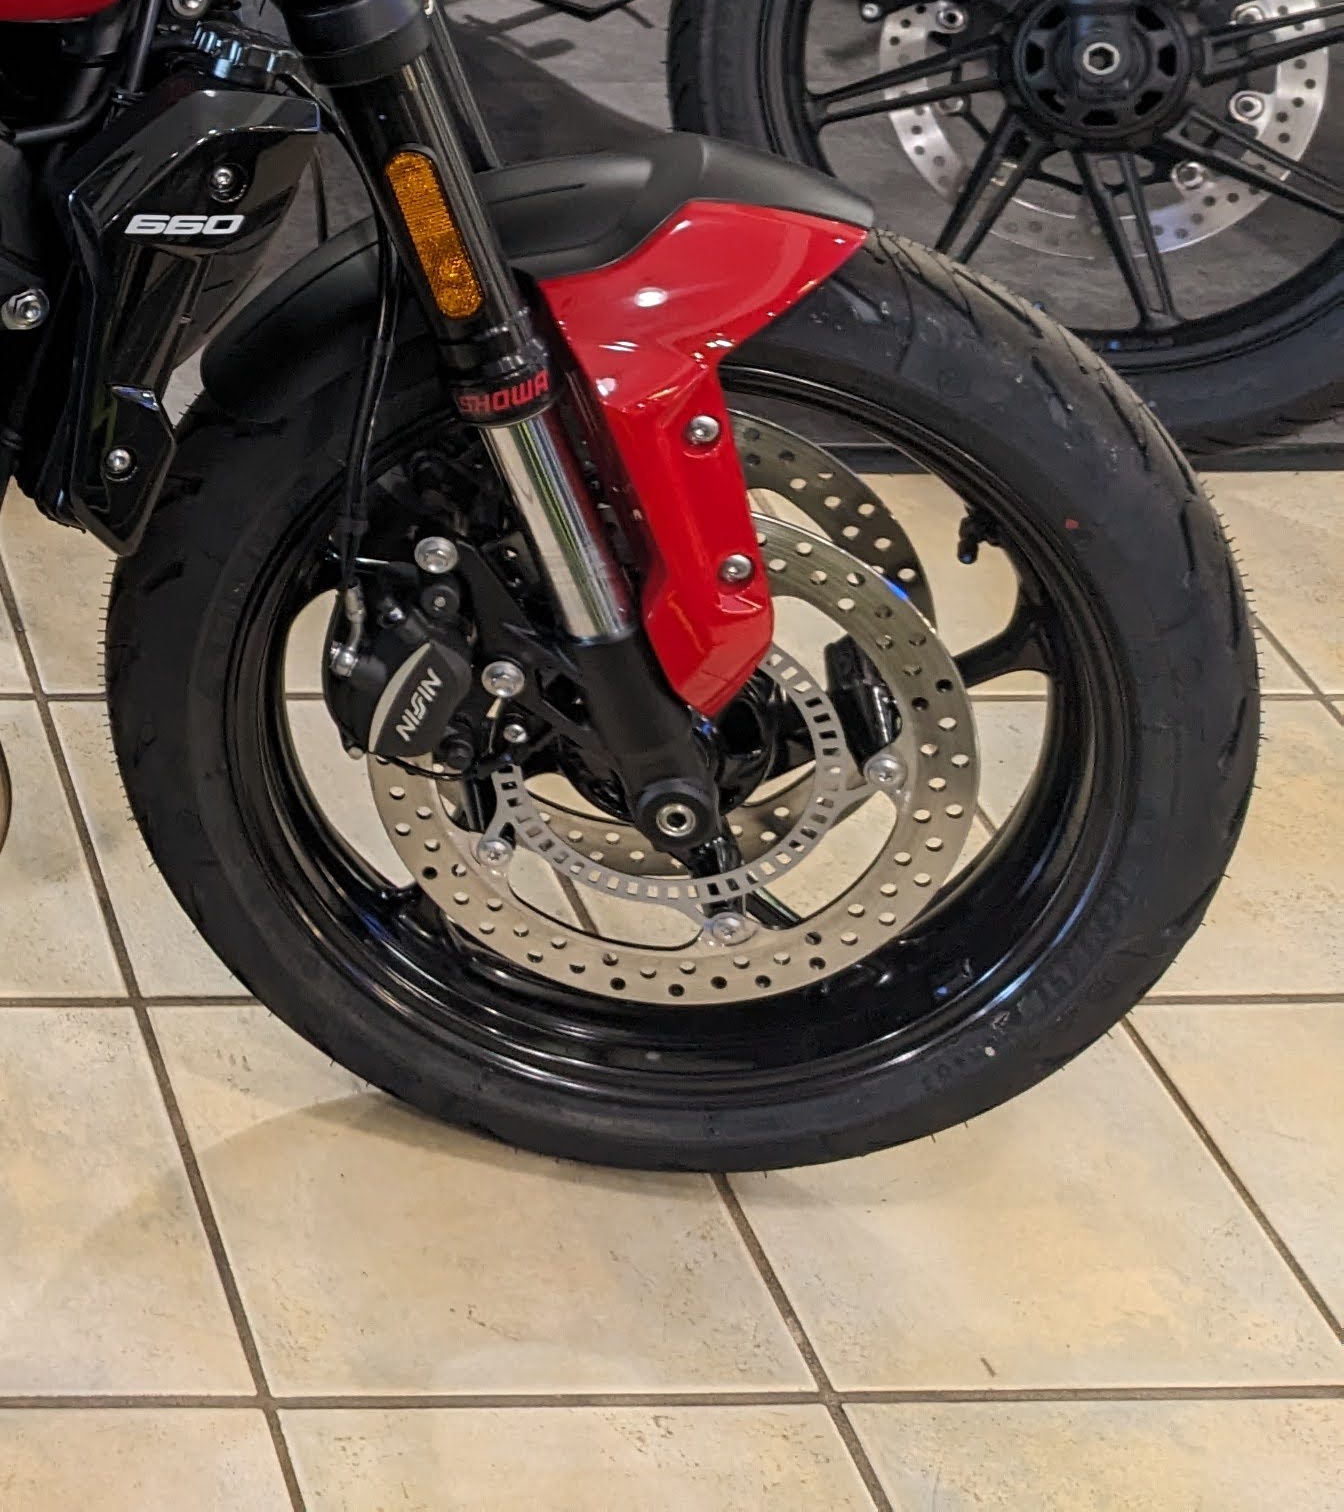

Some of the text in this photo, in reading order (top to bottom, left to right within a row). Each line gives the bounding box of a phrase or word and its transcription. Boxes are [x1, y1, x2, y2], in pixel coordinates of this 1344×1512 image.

[124, 214, 245, 235] 660
[458, 369, 551, 413] SHOWA
[395, 667, 443, 742] NISSIN
